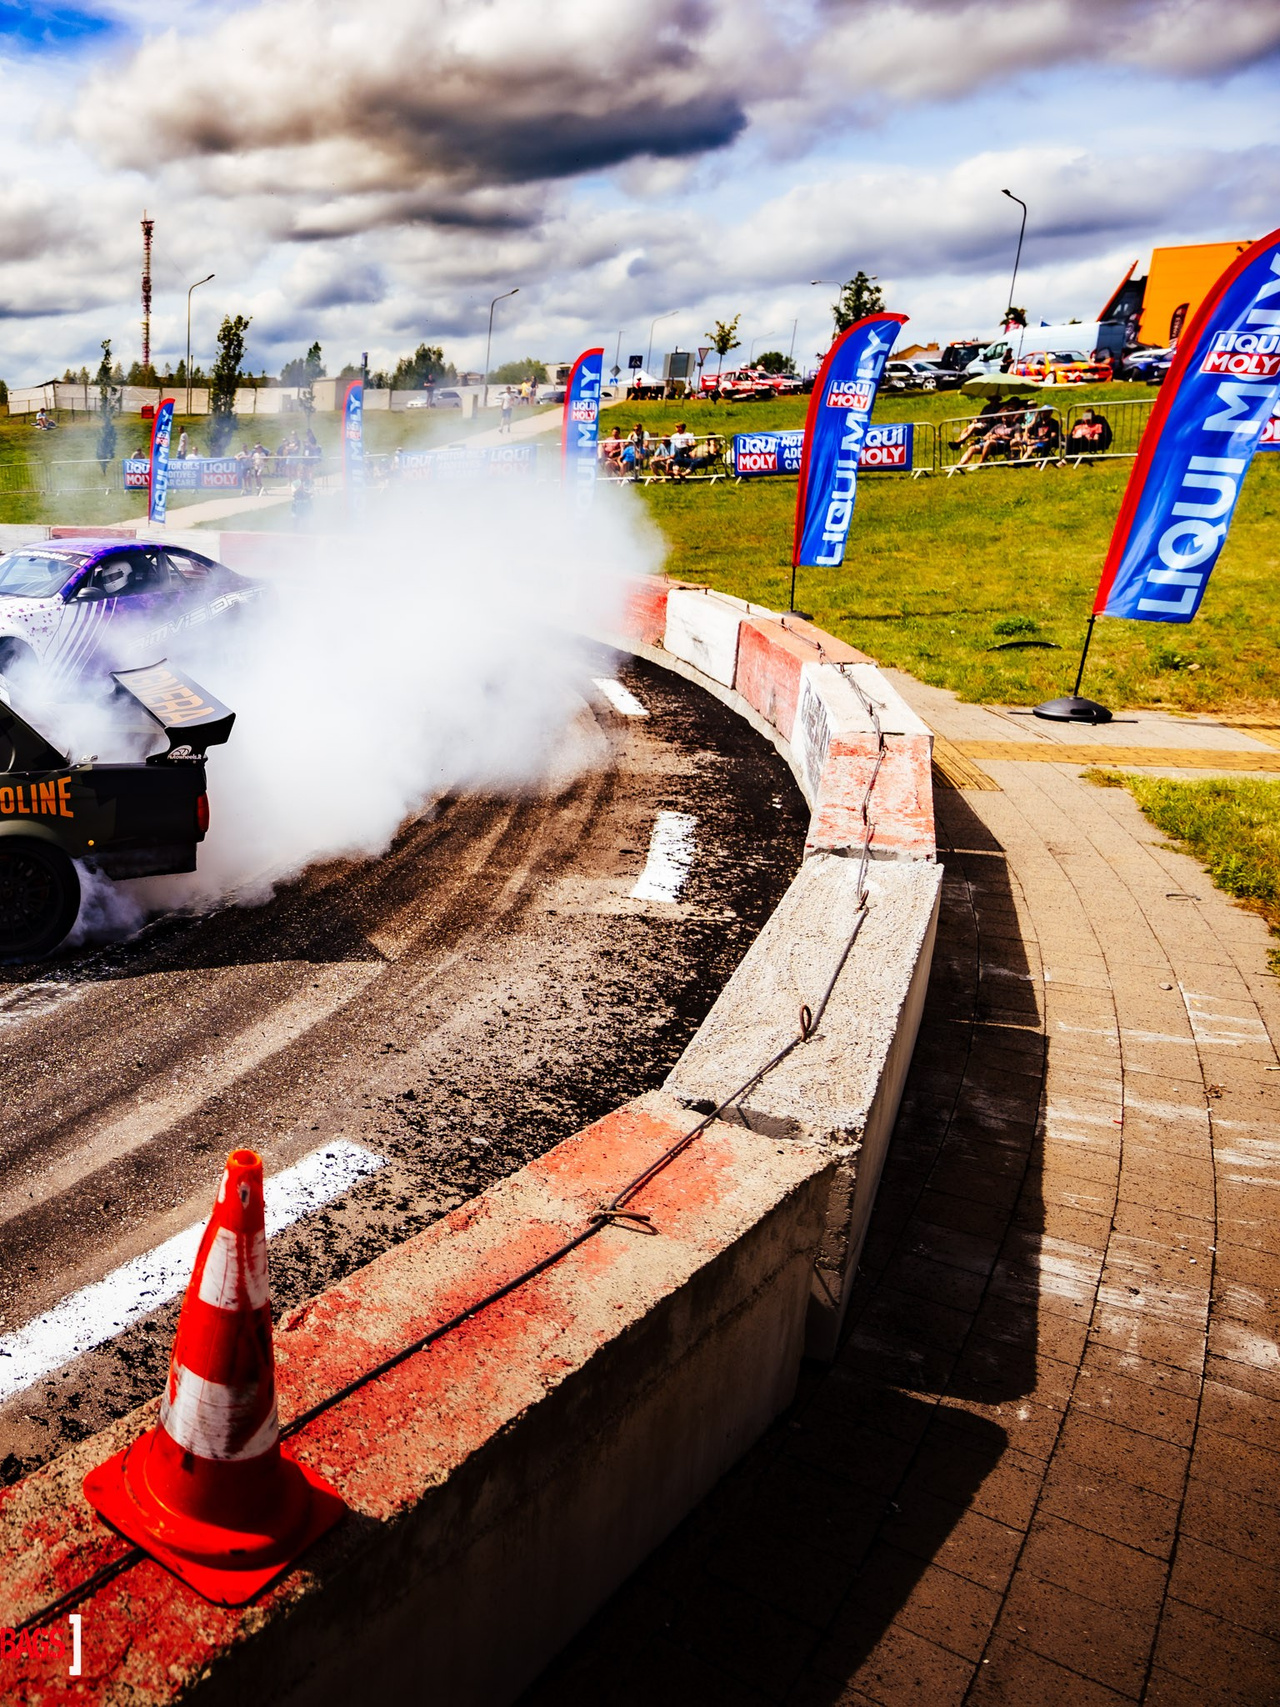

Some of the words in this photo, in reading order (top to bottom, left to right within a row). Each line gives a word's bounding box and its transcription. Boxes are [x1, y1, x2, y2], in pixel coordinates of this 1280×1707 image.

[1218, 334, 1280, 354] LIQU
[1204, 353, 1279, 375] MOLY
[832, 382, 870, 395] LIQUI
[573, 401, 596, 411] LIQUI
[578, 365, 601, 448] MLY
[830, 395, 868, 409] MOLY
[572, 410, 596, 420] MOLY
[740, 437, 777, 453] LIQUI
[781, 436, 804, 447] MOT
[490, 447, 531, 462] LIQUI
[126, 461, 150, 473] LIQU
[204, 462, 236, 473] LIQUI
[739, 455, 775, 470] MOLY
[176, 477, 197, 485] CARE
[204, 474, 237, 485] MOLY
[155, 470, 168, 521] LIQUI
[816, 459, 857, 566] LIQUI
[1137, 456, 1246, 615] LIQUI
